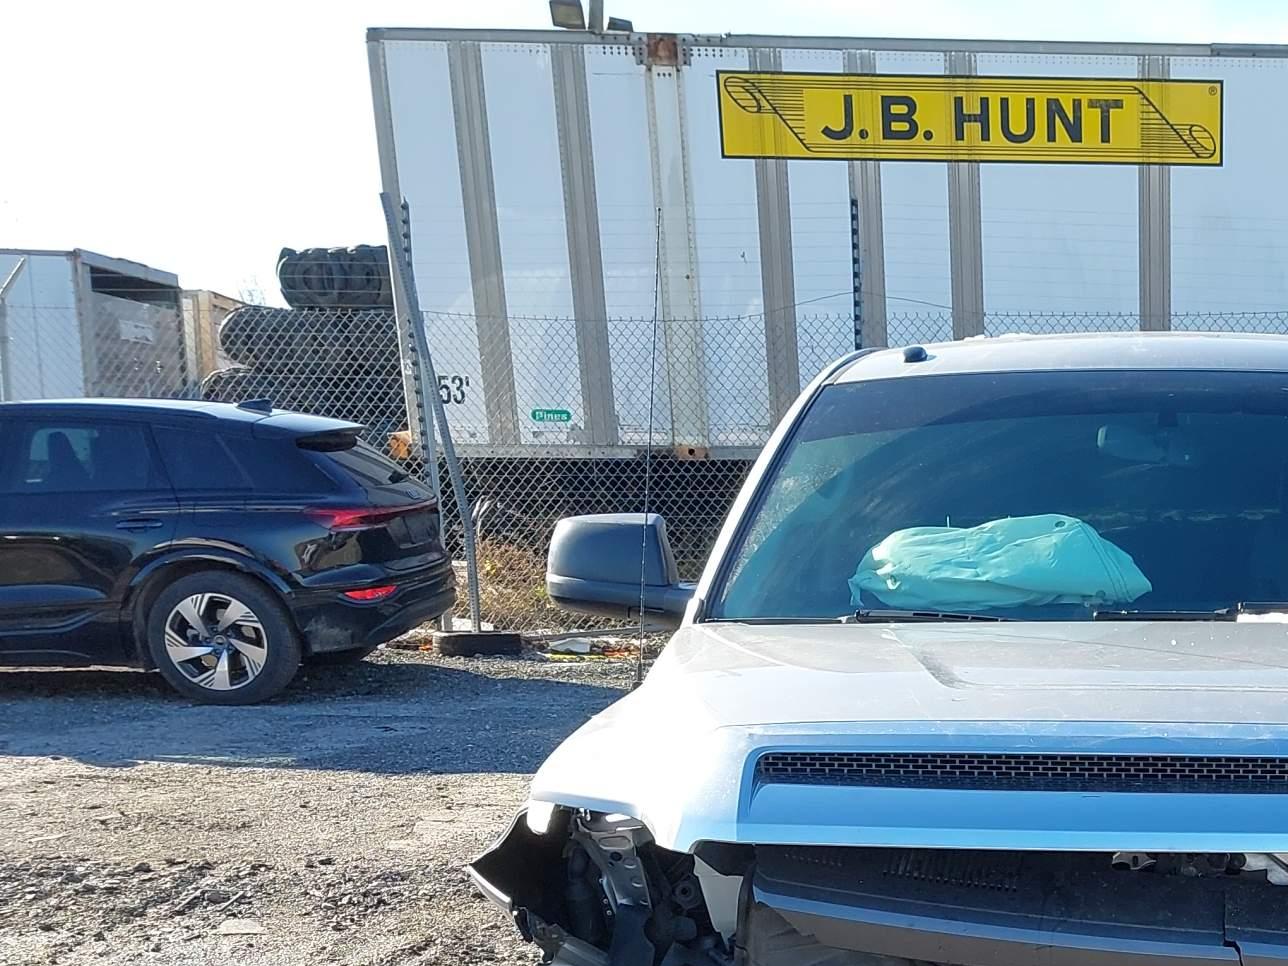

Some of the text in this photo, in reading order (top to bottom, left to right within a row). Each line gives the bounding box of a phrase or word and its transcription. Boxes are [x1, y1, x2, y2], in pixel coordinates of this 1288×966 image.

[821, 94, 1123, 143] J.B. HUNT
[535, 411, 568, 420] Pines
